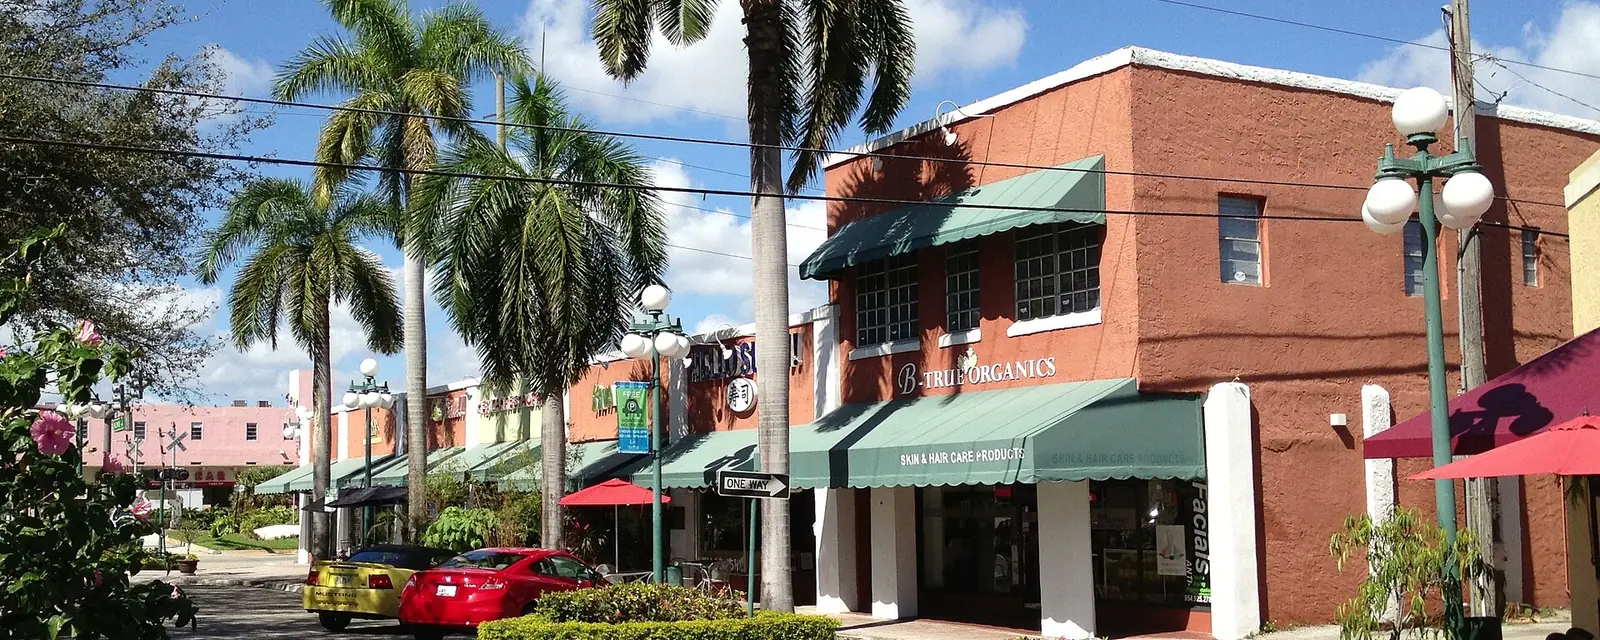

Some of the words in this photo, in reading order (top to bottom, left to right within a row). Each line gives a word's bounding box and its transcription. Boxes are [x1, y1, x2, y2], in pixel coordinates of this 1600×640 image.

[968, 357, 1055, 385] ORGANICS
[900, 454, 919, 466] SKIN
[921, 453, 927, 464] &
[929, 452, 949, 464] HAIR
[950, 451, 974, 463] CARE
[976, 447, 1025, 462] PRODUCTS
[1053, 453, 1074, 464] SKIN
[1086, 453, 1108, 464] HAIR
[1110, 453, 1135, 464] CARE
[726, 478, 746, 489] ONE
[749, 480, 769, 490] WAY
[1192, 481, 1209, 575] Facials
